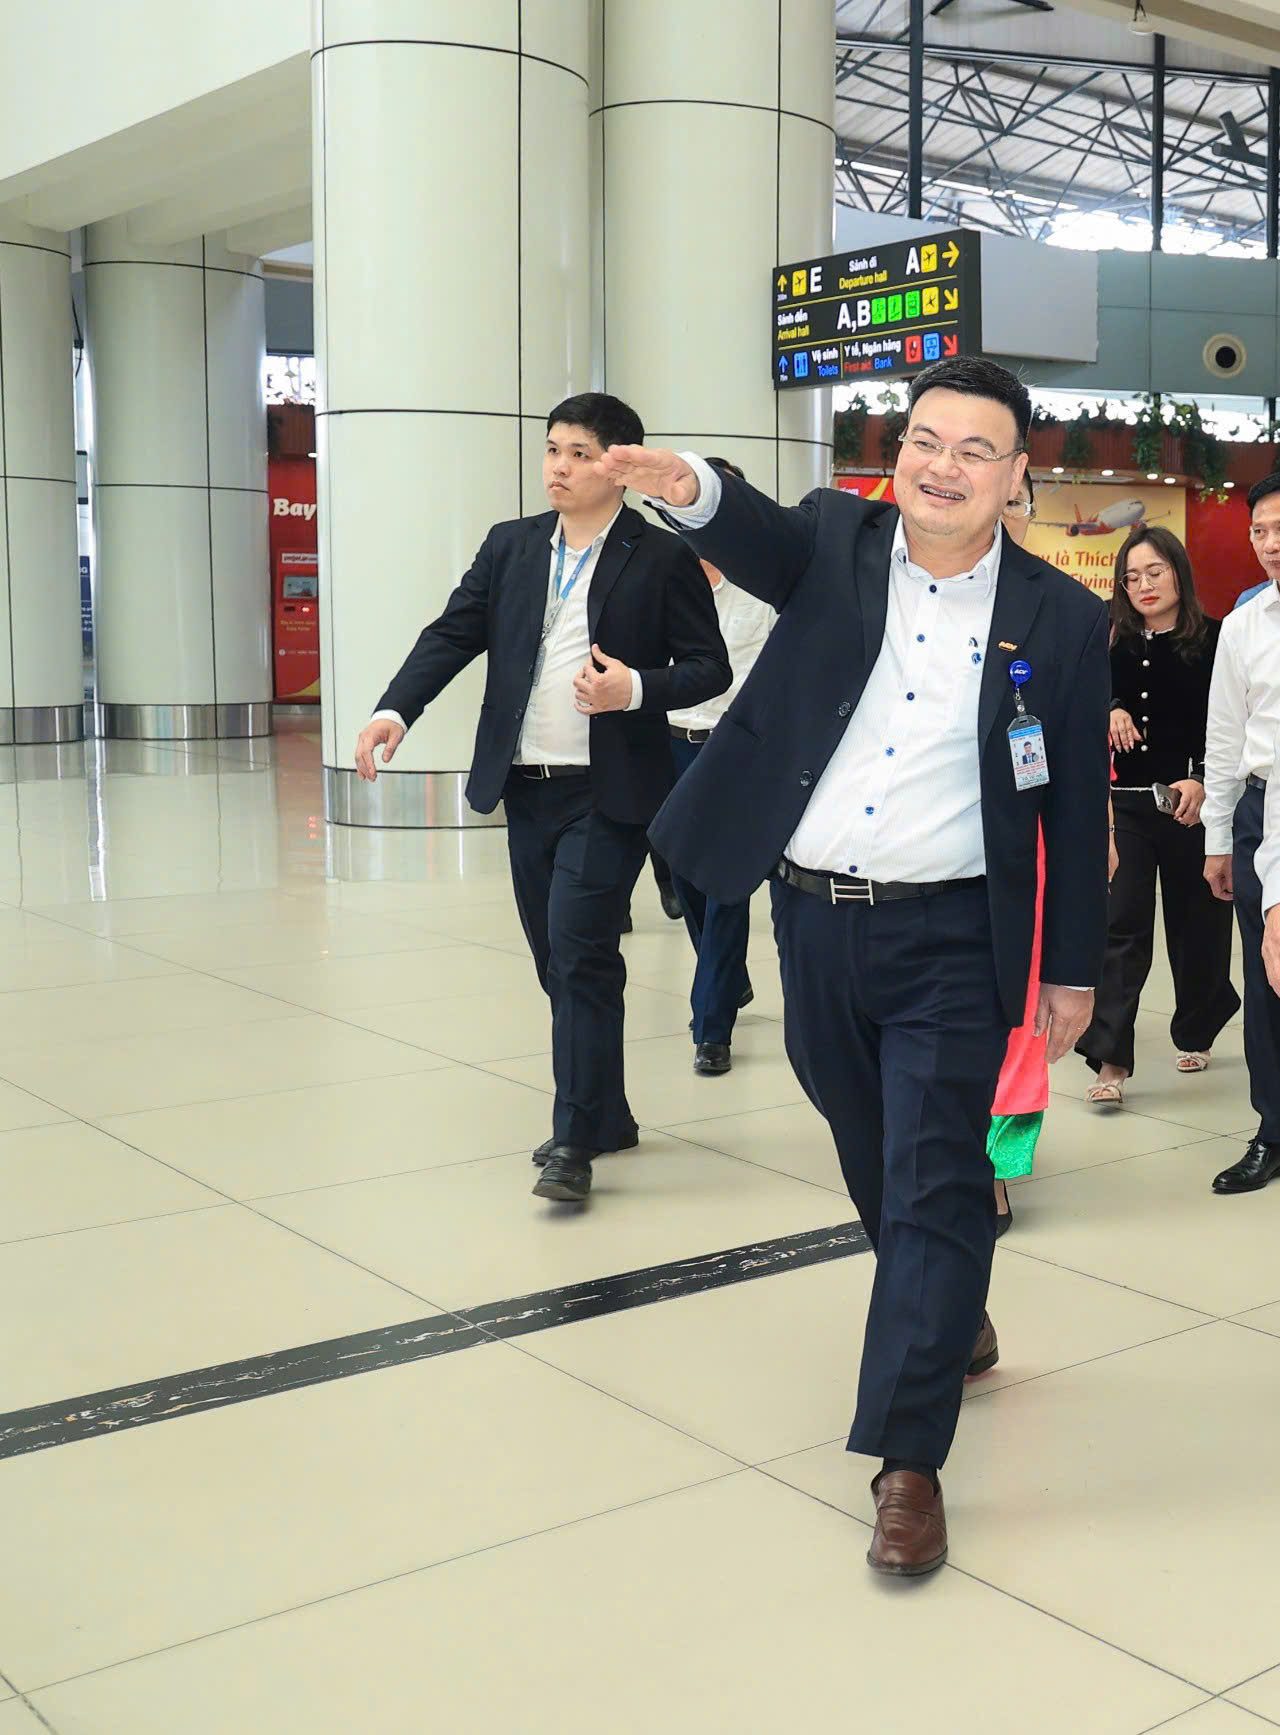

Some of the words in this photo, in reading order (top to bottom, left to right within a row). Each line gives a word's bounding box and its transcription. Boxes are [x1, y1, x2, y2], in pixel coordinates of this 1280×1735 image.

[905, 247, 920, 275] A
[810, 266, 822, 293] E
[839, 274, 873, 290] Departure
[874, 270, 888, 283] hall
[777, 326, 797, 341] Arrival
[798, 325, 810, 338] hall
[823, 347, 838, 361] sinh
[844, 345, 850, 357] Y
[817, 364, 839, 377] Toilets
[874, 356, 893, 369] Bank
[273, 498, 317, 521] Bay
[1055, 550, 1070, 566] là
